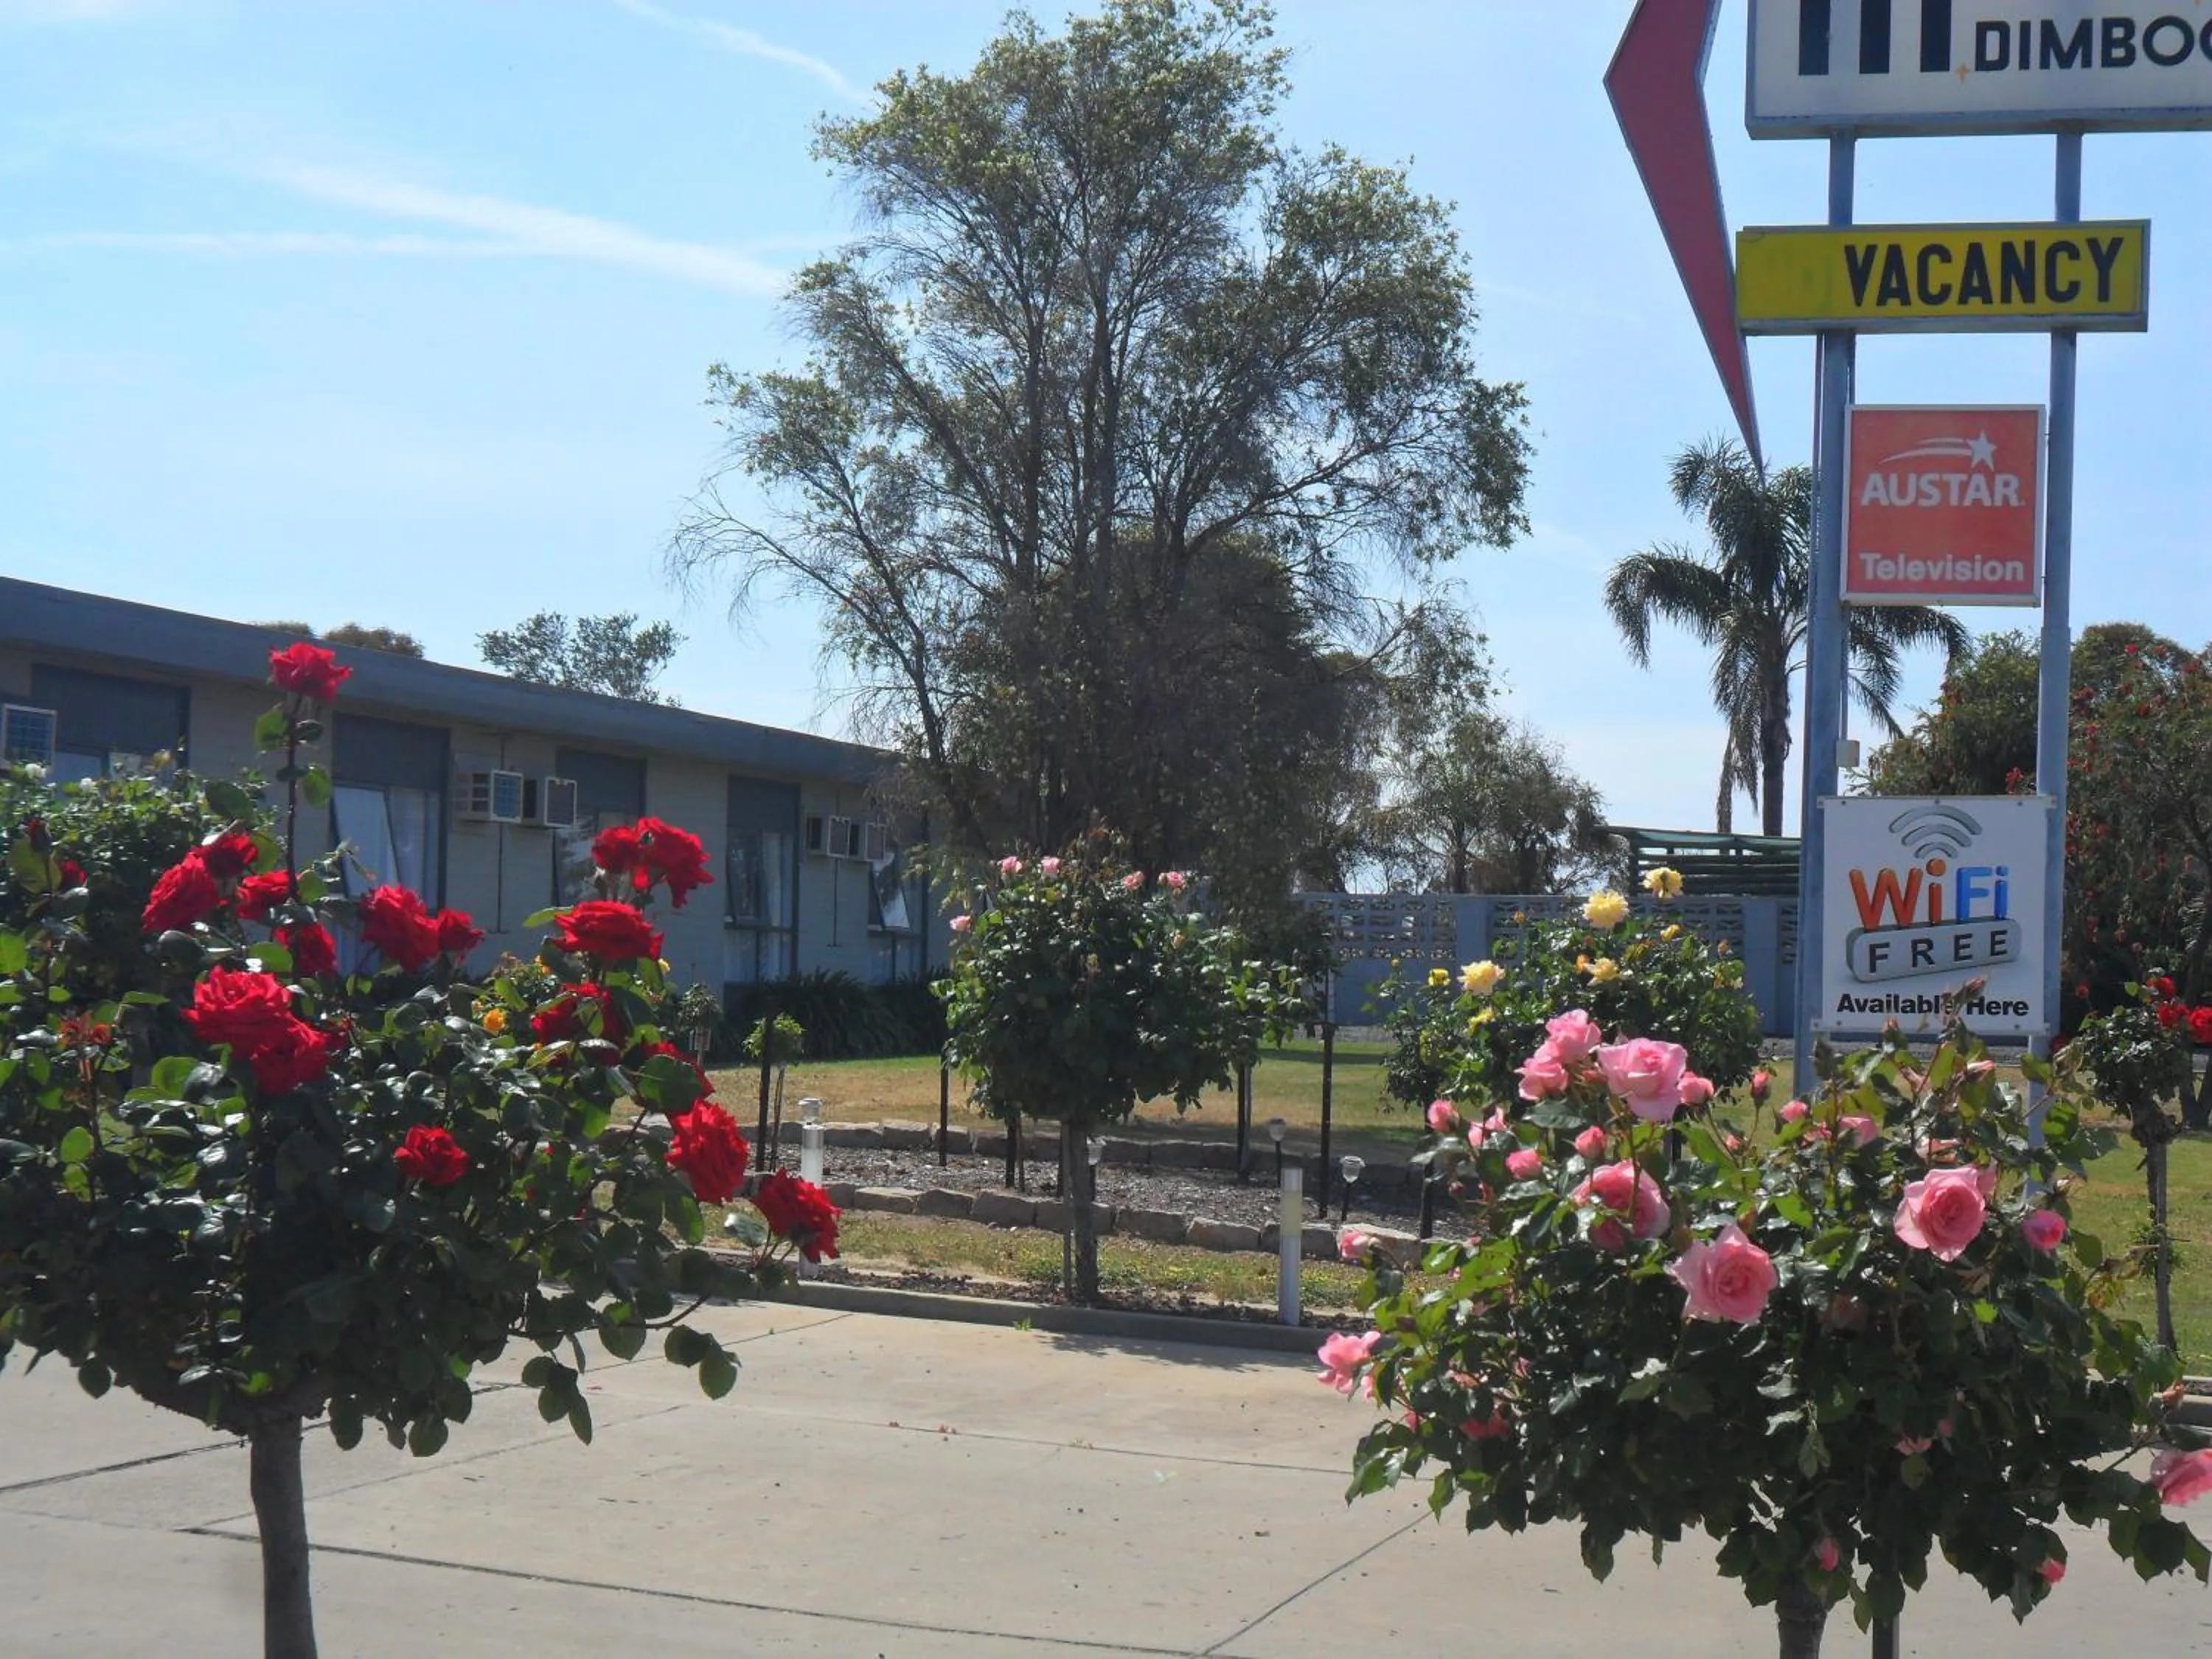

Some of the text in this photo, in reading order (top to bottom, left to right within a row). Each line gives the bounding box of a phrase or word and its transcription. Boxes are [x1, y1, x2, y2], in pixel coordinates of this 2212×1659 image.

[1975, 15, 2212, 72] DIMBO
[1844, 236, 2124, 307] VACANCY
[1860, 472, 2021, 507] AUSTAR
[1859, 552, 2025, 581] Television
[1848, 858, 2009, 931] WiFi
[1868, 929, 2008, 974] FREE
[1966, 995, 2030, 1016] Here
